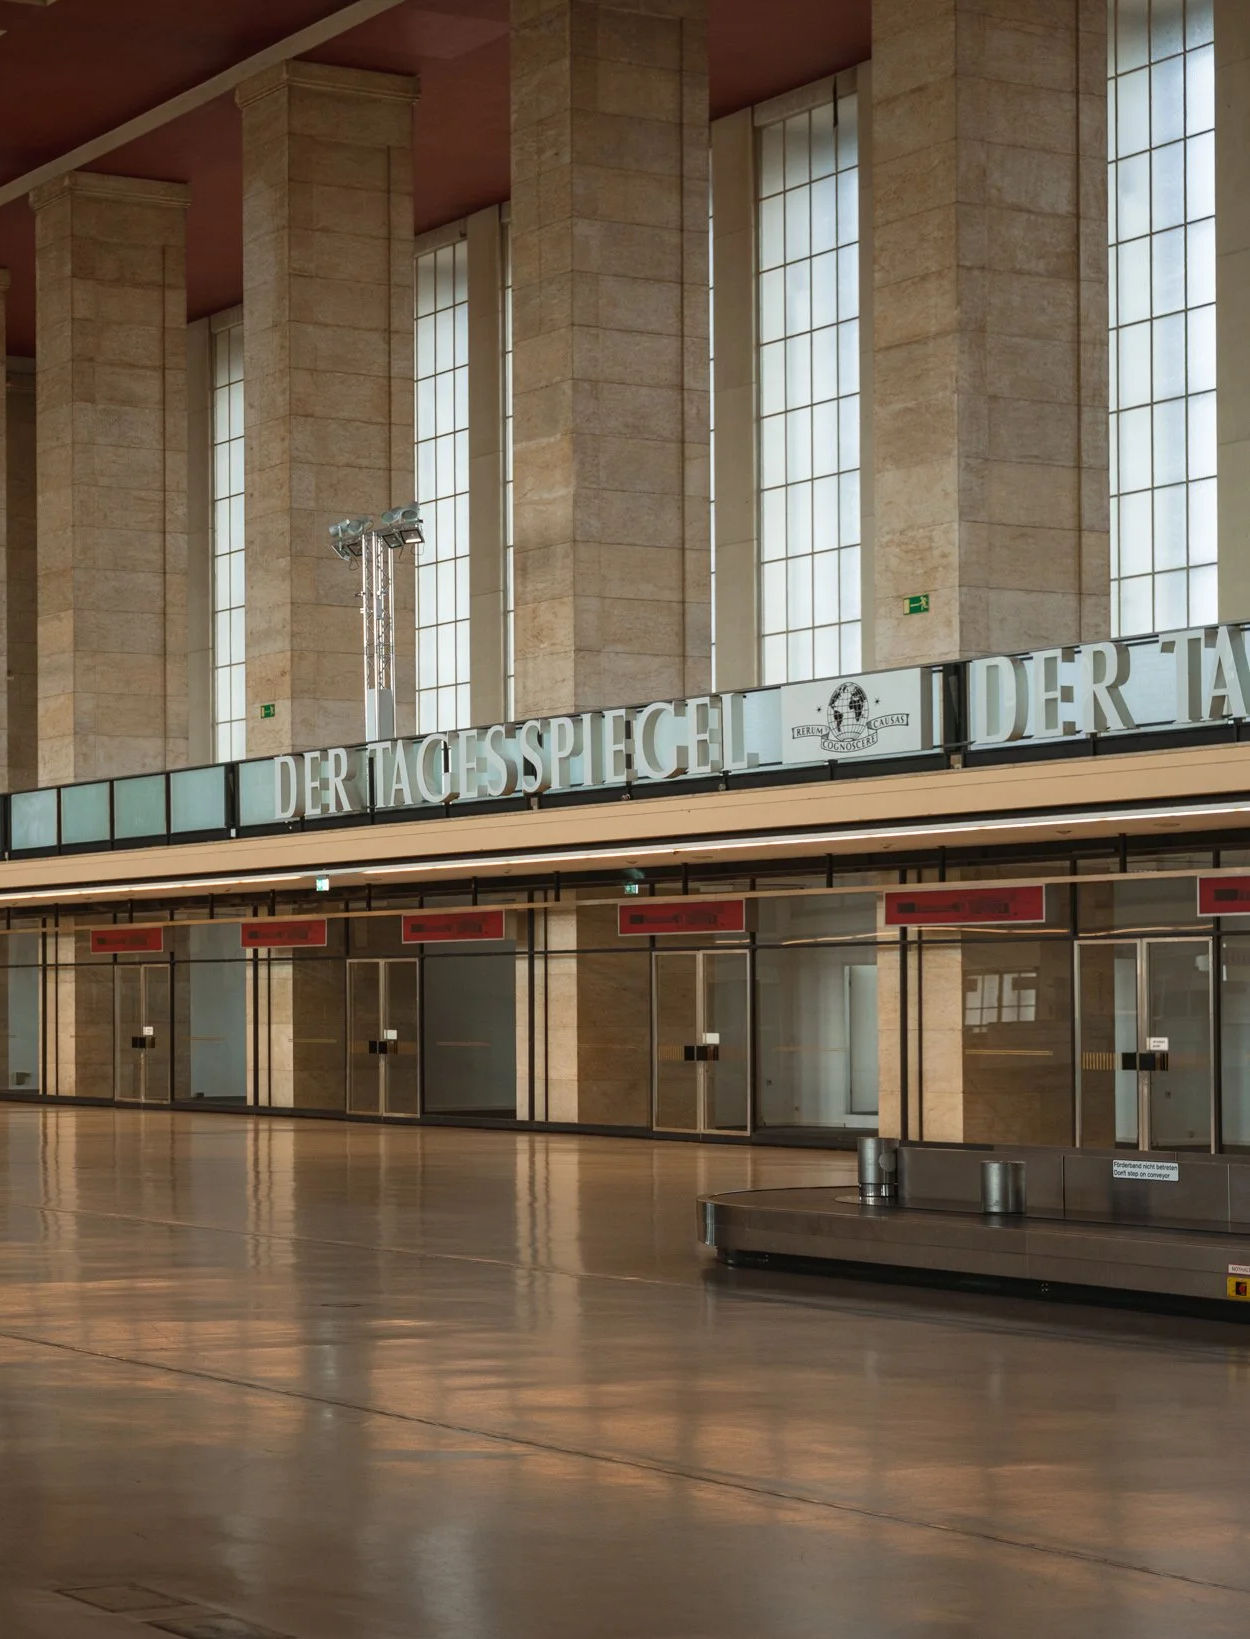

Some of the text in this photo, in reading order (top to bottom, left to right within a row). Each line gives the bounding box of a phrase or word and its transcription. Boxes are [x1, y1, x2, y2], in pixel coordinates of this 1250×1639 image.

[972, 626, 1250, 744] DER TA
[274, 692, 752, 820] DER TAGESSPIEGEL
[796, 715, 905, 751] RERUM COGNOSCERE CAUSAS
[1156, 1163, 1177, 1171] betreten
